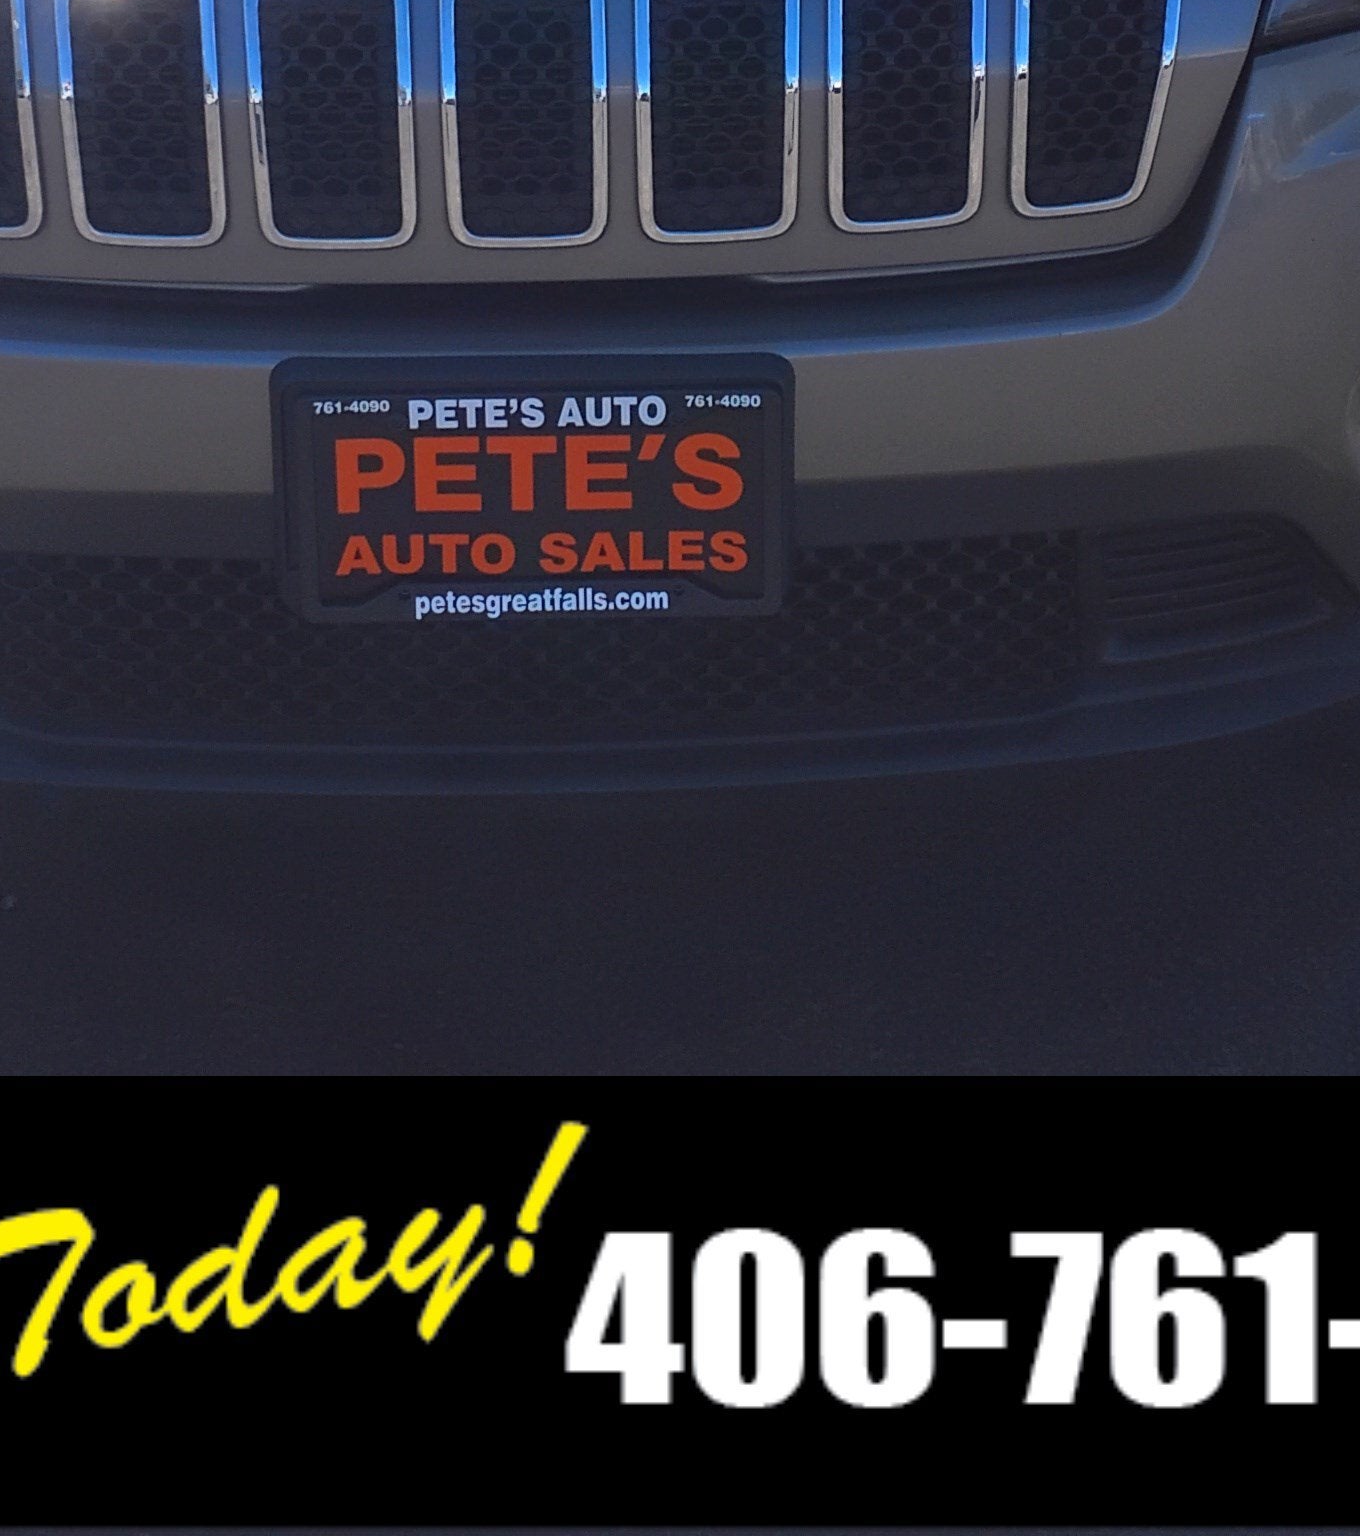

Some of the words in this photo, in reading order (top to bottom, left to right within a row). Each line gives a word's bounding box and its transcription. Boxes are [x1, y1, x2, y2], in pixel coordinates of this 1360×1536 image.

[313, 399, 390, 415] 761-4090
[408, 397, 545, 430] PETE'S
[557, 395, 667, 427] AUTO
[684, 394, 761, 409] 761-4090
[335, 433, 744, 514] PETE'S
[335, 533, 516, 576] AUTO
[539, 531, 748, 573] SALES
[415, 587, 669, 620] petesgreatfalls.com
